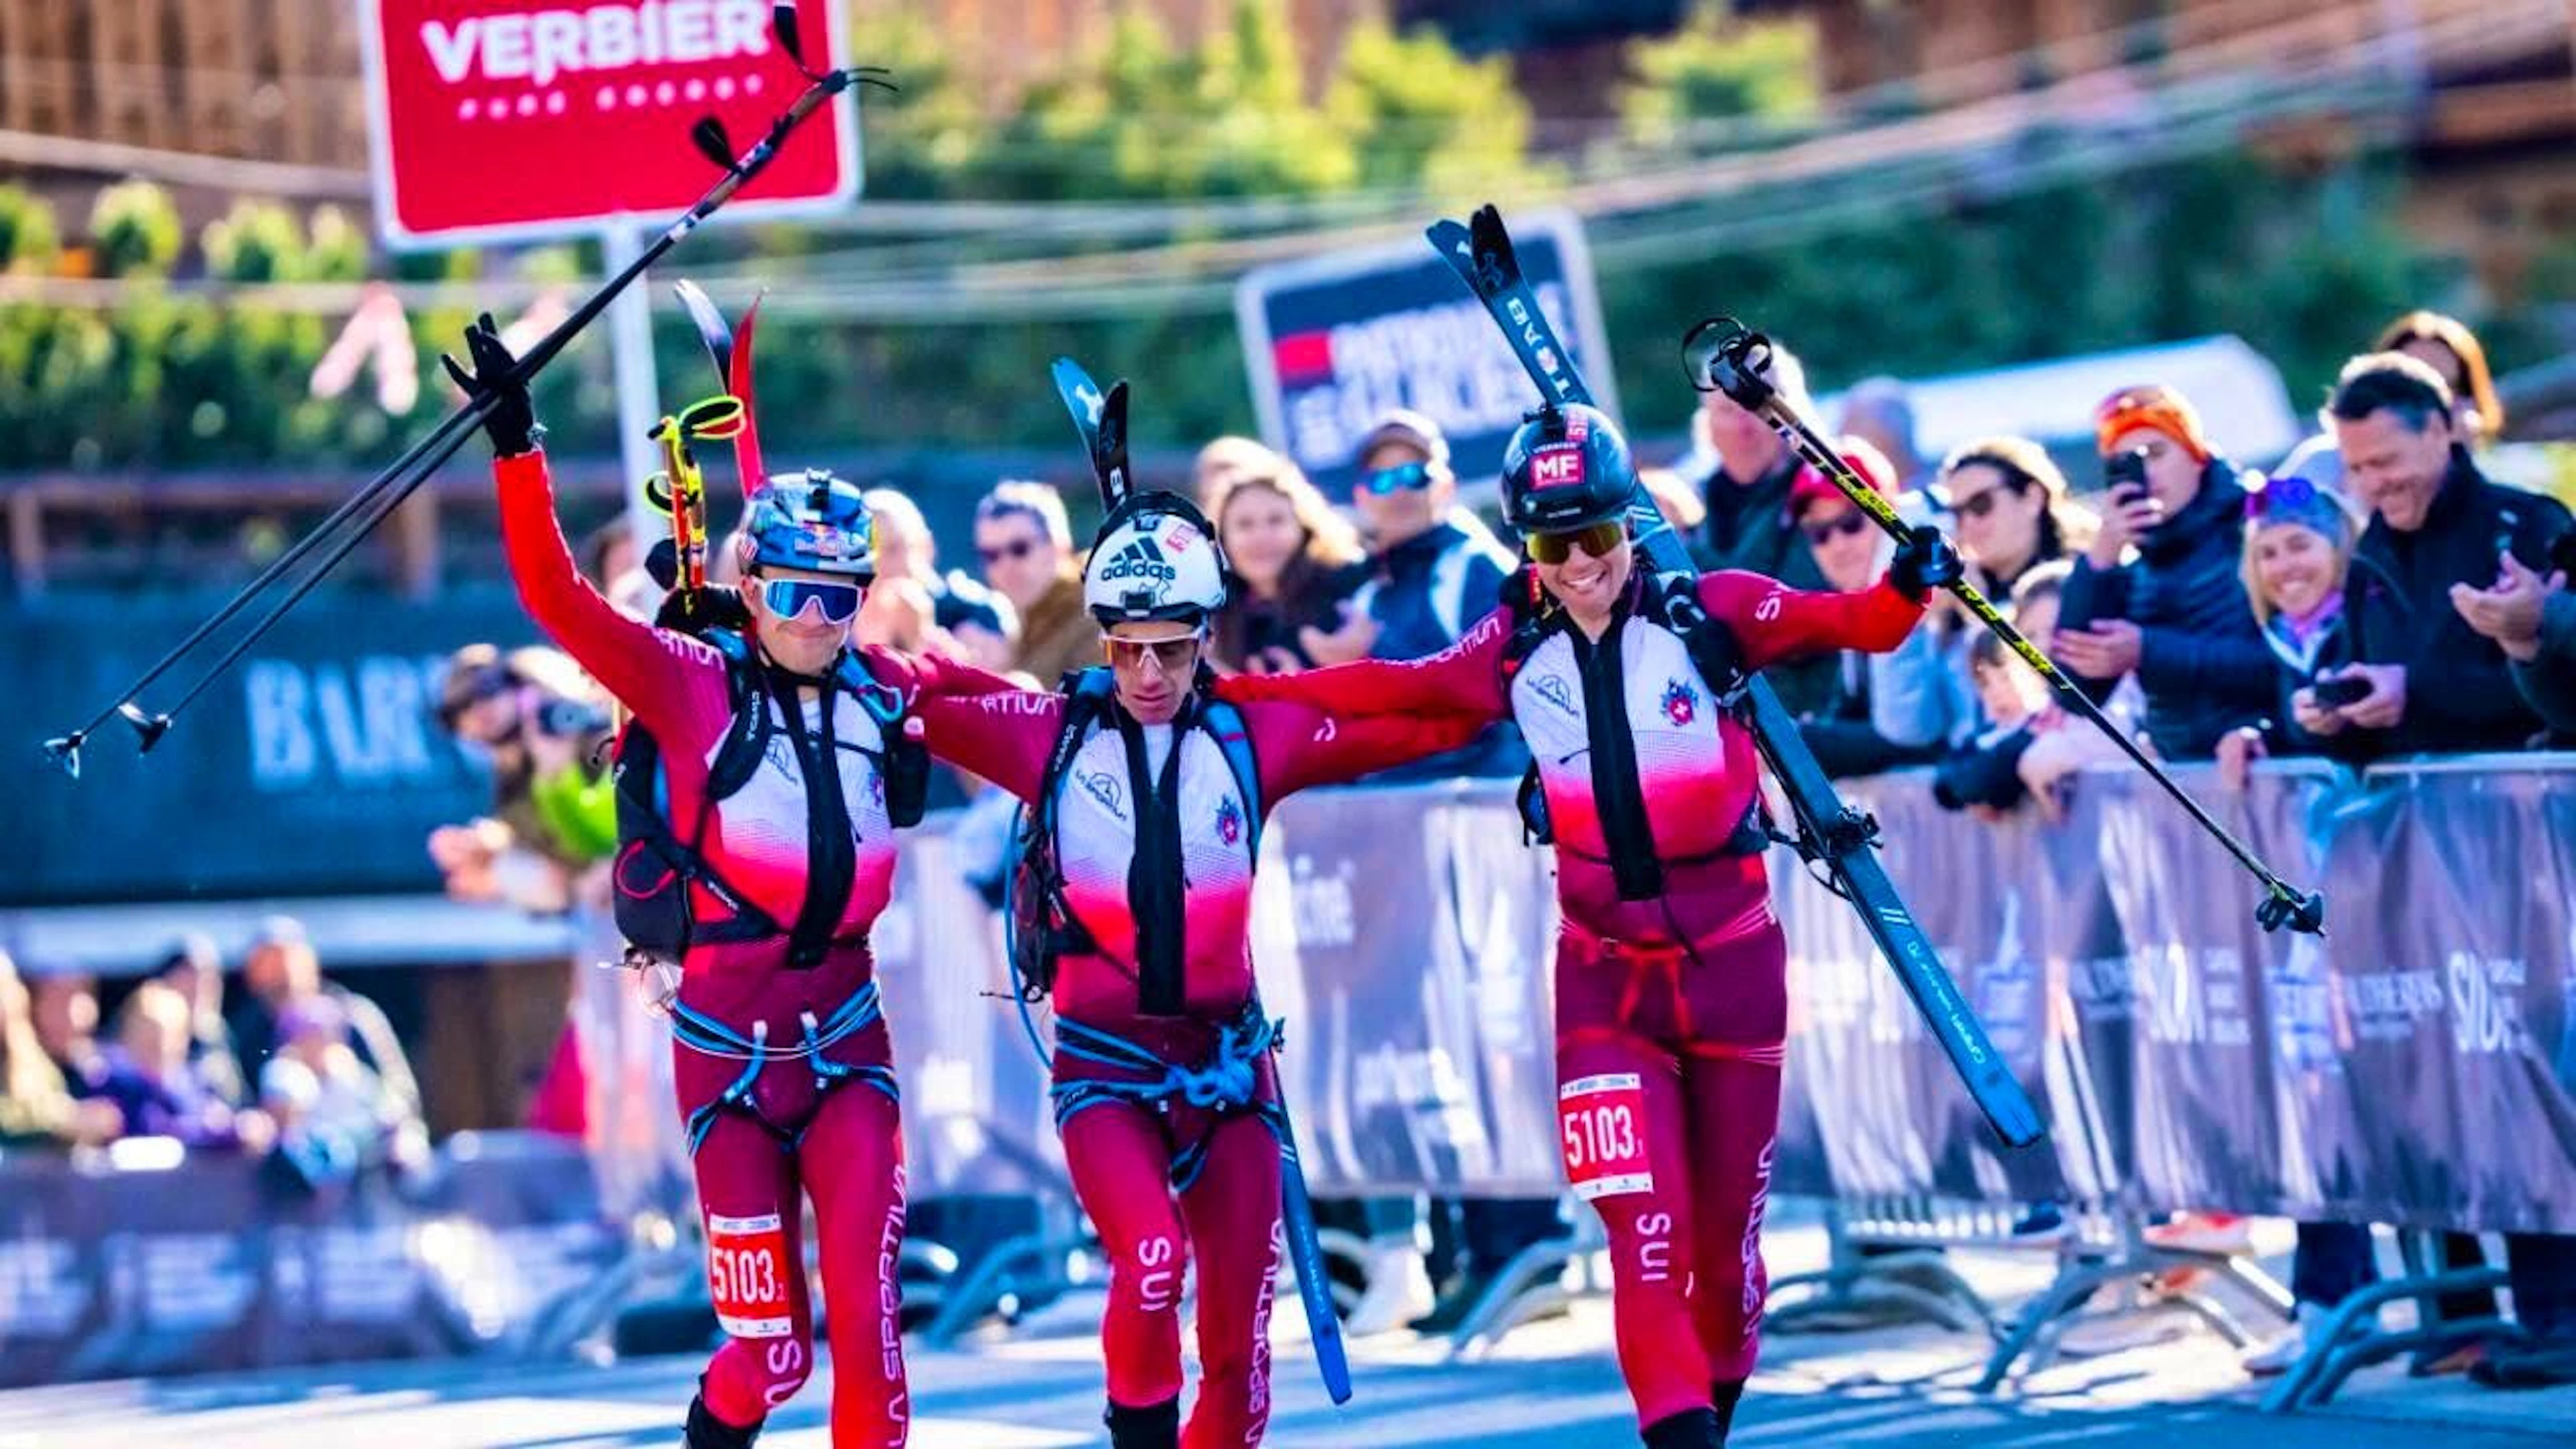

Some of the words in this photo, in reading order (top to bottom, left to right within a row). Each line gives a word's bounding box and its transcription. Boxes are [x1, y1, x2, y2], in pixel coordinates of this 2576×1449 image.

[420, 1, 770, 87] VERBIER
[1534, 454, 1579, 482] MF
[1101, 559, 1176, 582] adidas
[1564, 1104, 1635, 1169] 5103
[710, 1246, 776, 1304] 5103
[878, 1164, 907, 1382] SPORTIVA
[1138, 1236, 1172, 1311] SUI
[1634, 1212, 1672, 1281] SUI
